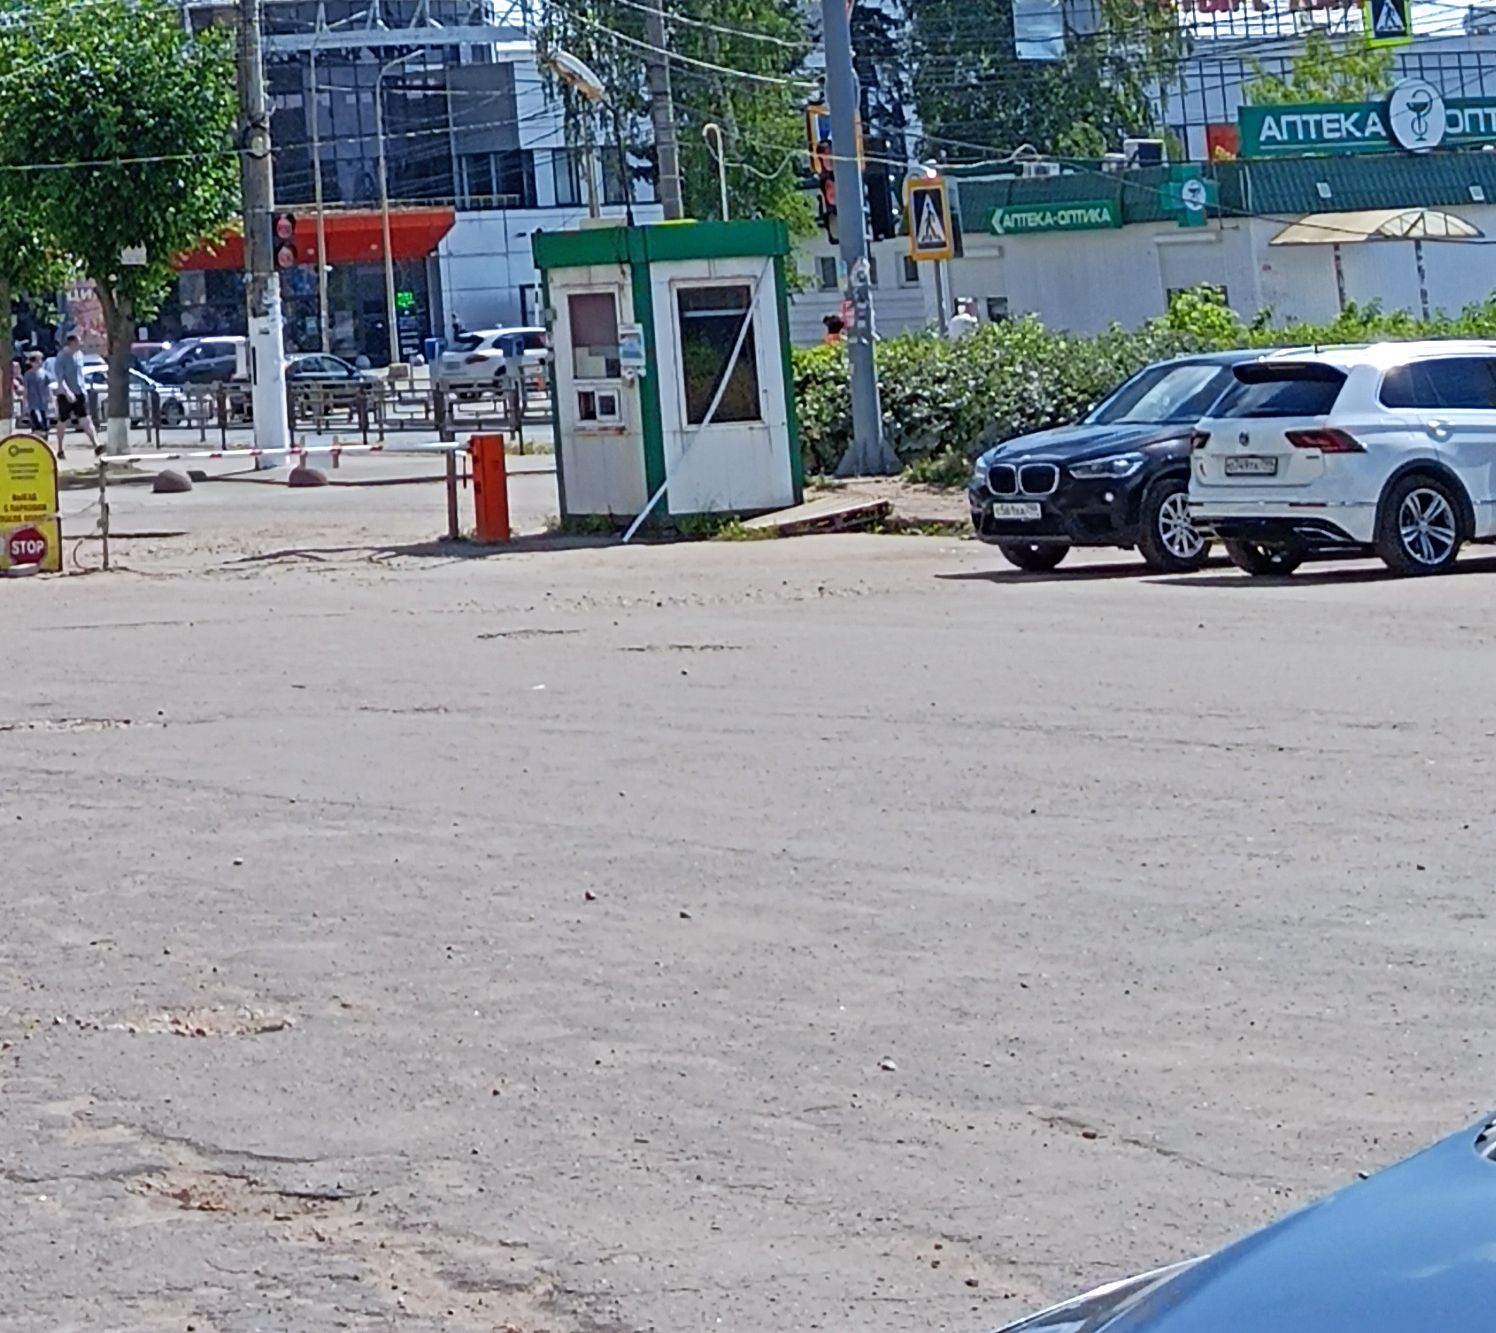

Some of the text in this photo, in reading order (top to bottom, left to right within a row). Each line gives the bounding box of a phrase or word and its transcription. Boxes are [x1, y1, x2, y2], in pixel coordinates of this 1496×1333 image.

[1258, 111, 1387, 142] АПТЕКА
[1002, 207, 1112, 228] АПТЕКА-ОПТИКА
[11, 540, 44, 555] STOP
